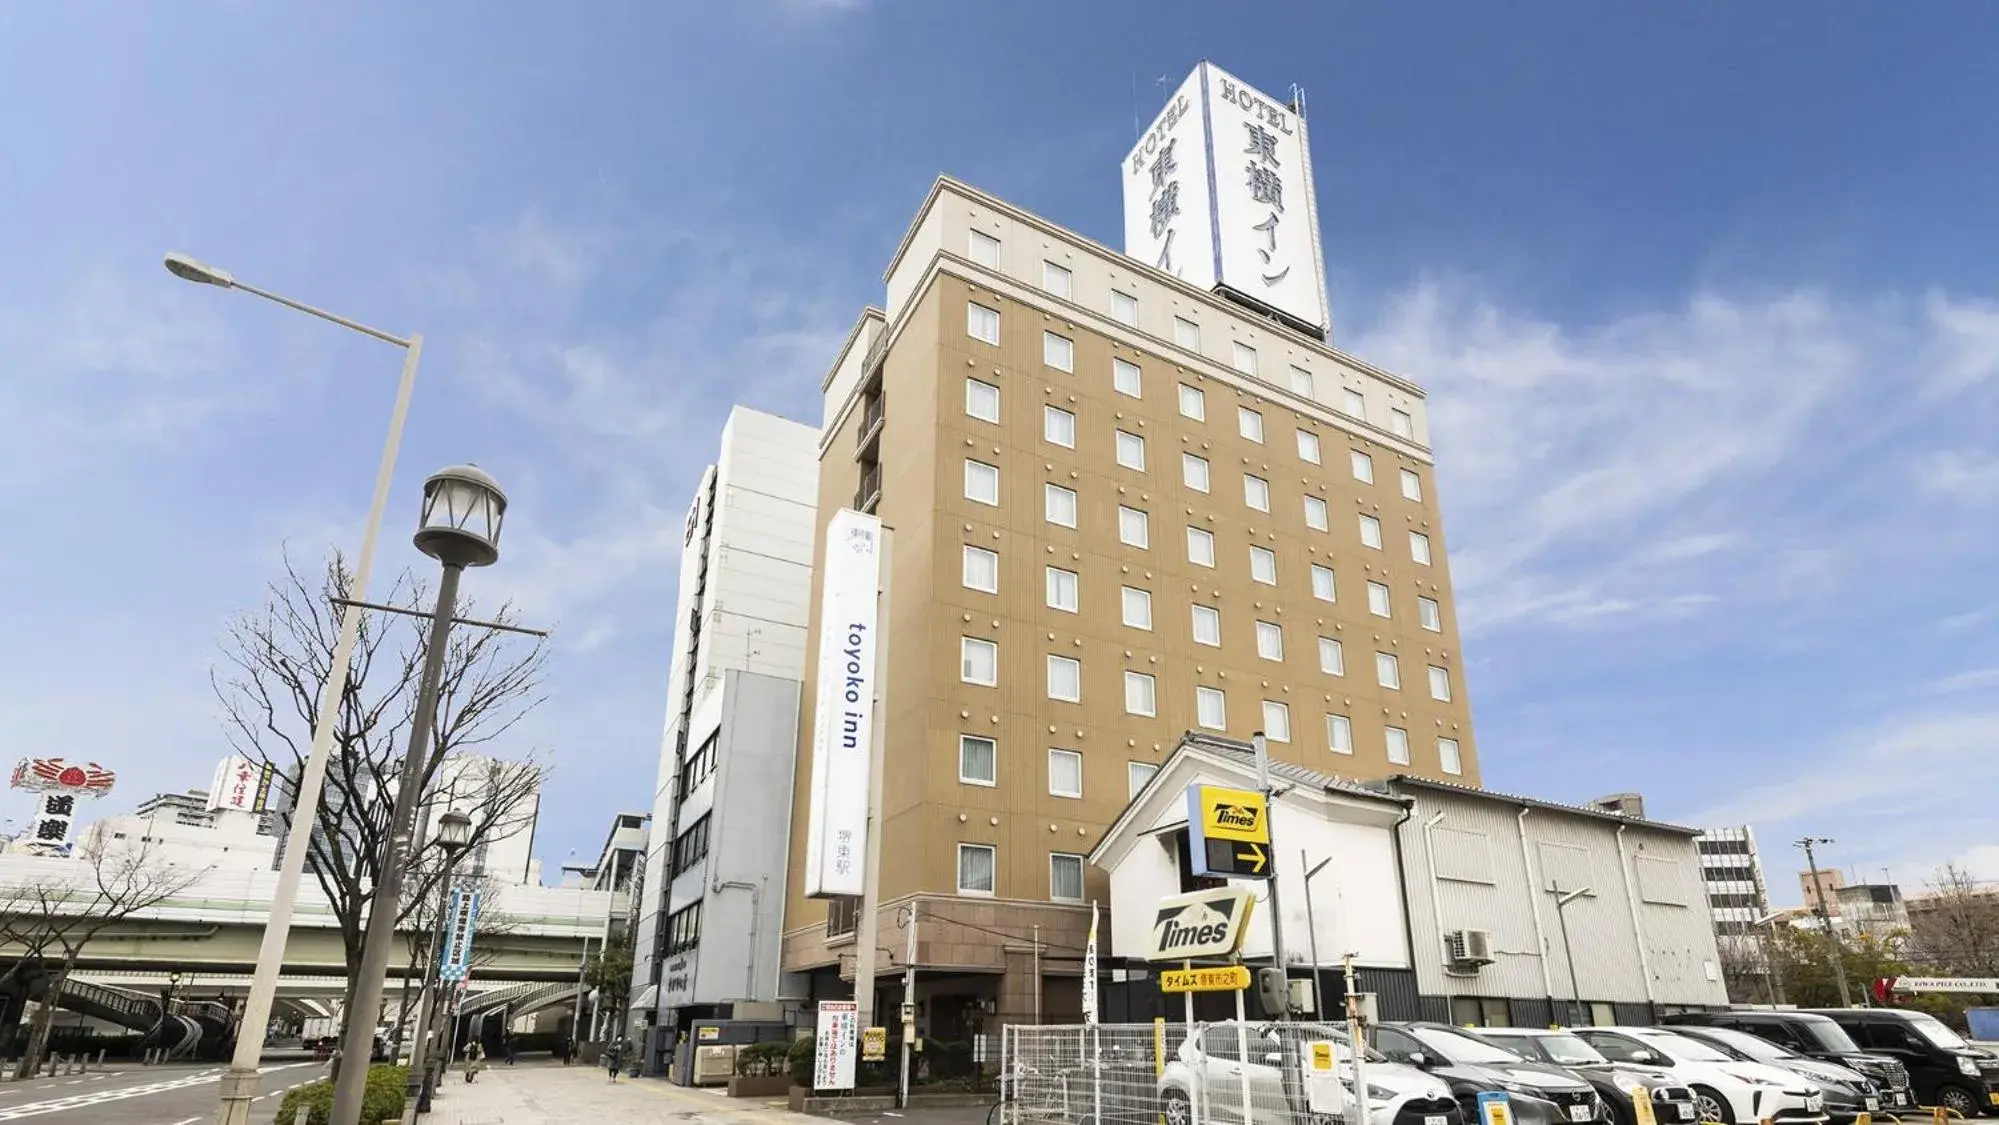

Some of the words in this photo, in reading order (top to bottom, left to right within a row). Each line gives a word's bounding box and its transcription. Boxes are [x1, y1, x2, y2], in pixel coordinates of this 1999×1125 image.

[1131, 95, 1190, 175] HOTEL
[1219, 77, 1293, 136] HOTEL
[1242, 121, 1290, 287] 東横イン
[843, 623, 866, 703] toyoko
[843, 711, 863, 749] inn
[1215, 805, 1256, 827] Times
[1156, 911, 1231, 952] Times
